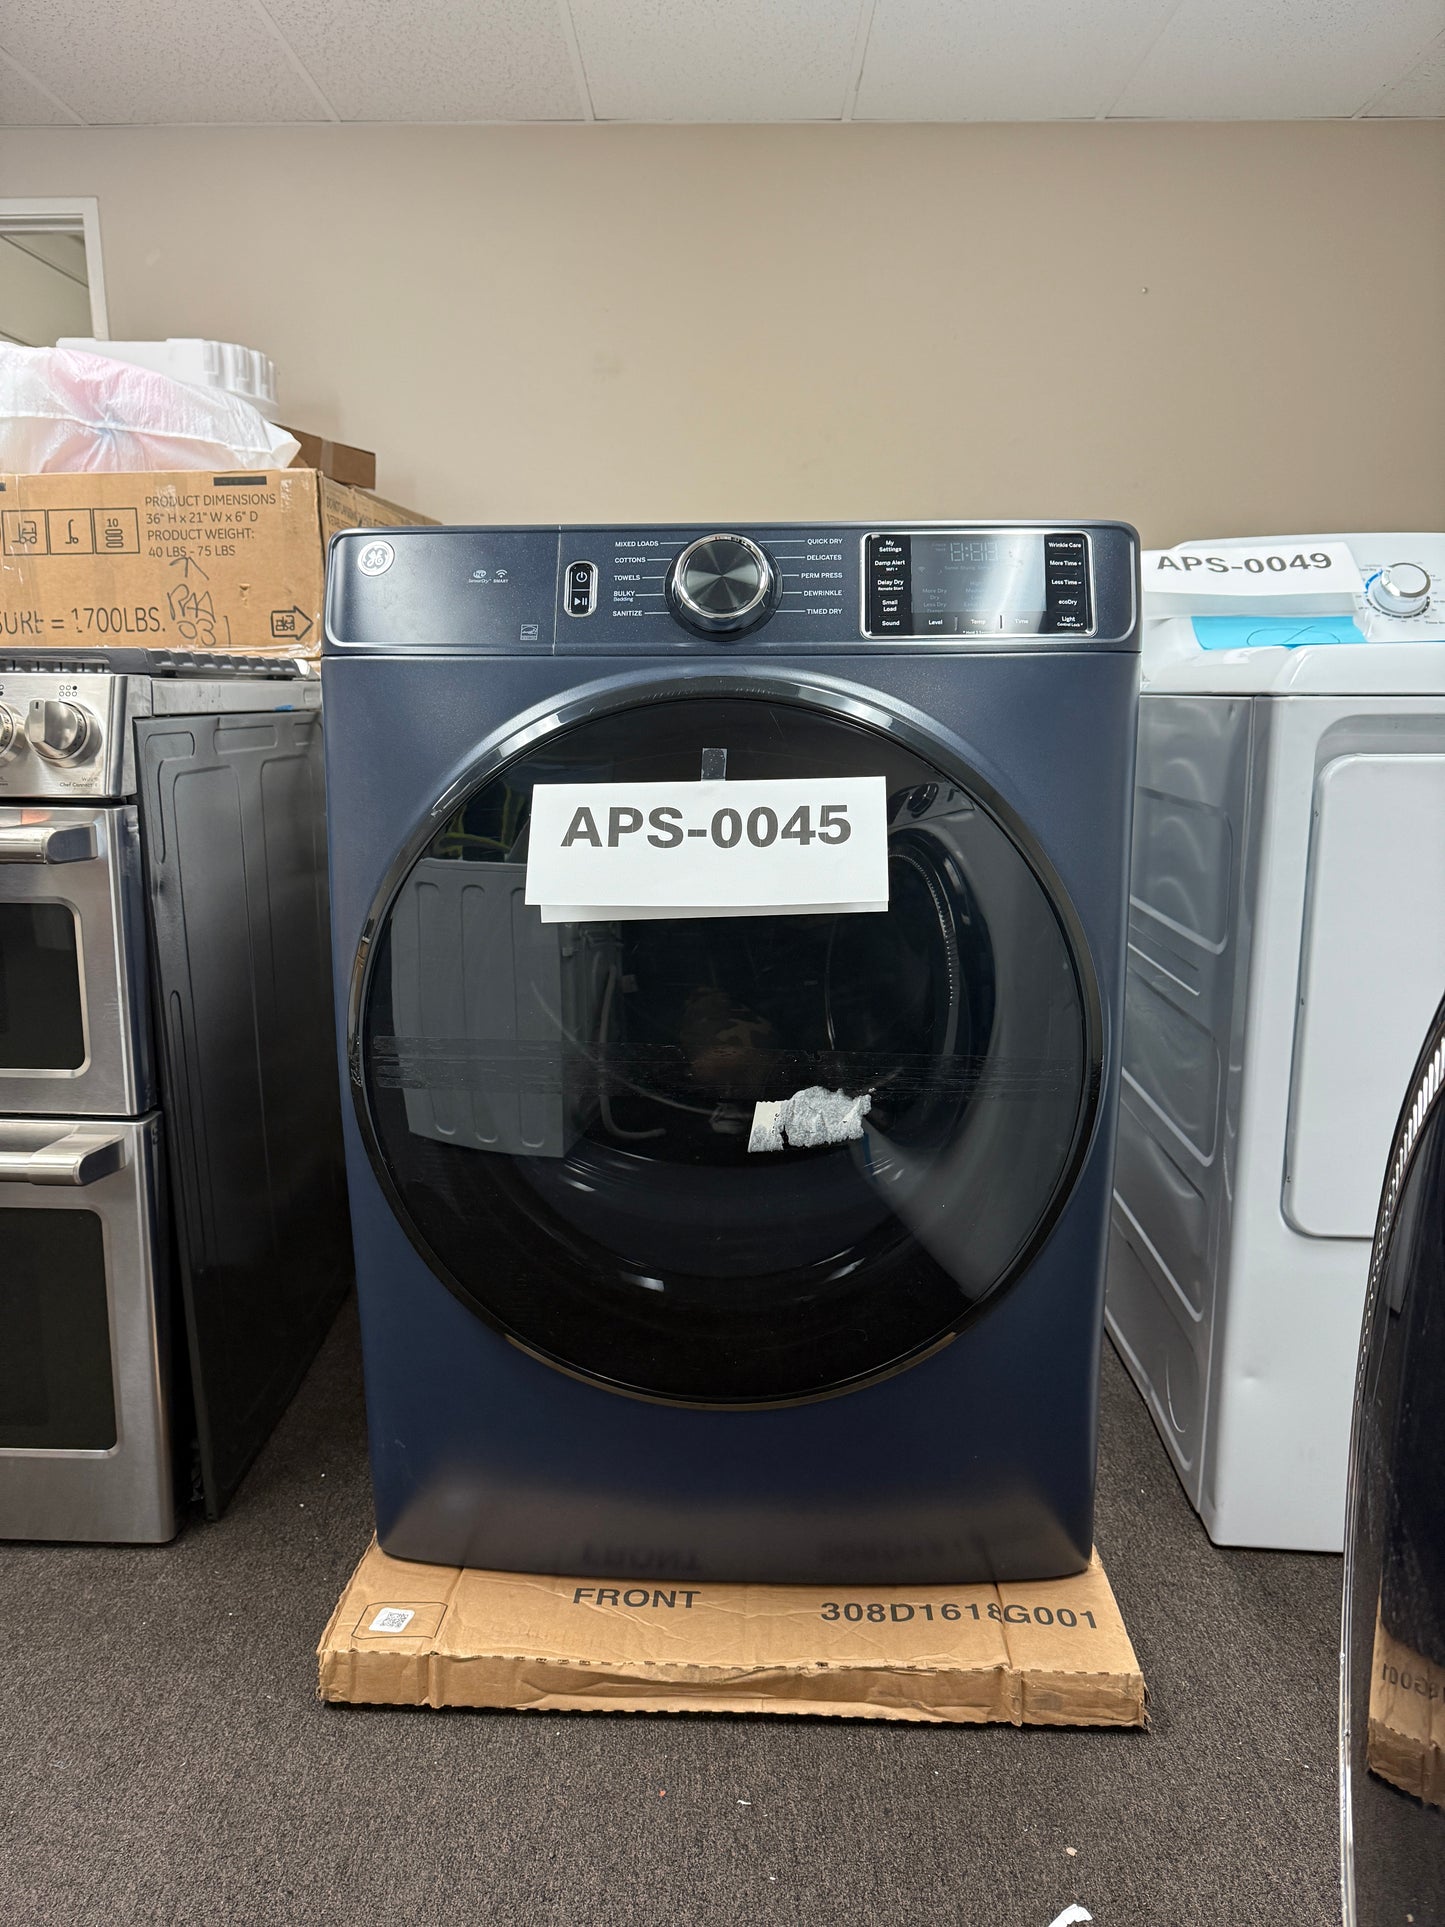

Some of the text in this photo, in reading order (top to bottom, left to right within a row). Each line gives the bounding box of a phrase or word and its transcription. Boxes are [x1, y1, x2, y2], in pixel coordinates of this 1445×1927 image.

[145, 493, 276, 507] PRODUCT DIMENSIONS
[107, 518, 119, 528] 10
[146, 511, 258, 524] 36" H x 21" W x 6" D
[147, 527, 255, 541] PRODUCT WEIGHT:
[148, 547, 163, 558] 40
[166, 546, 187, 557] LBS
[198, 545, 212, 557] 75
[215, 545, 236, 556] LBS
[1157, 552, 1332, 574] APS-0049
[0, 610, 44, 635] URE
[560, 804, 852, 849] APS-0045
[573, 1588, 701, 1608] FRONT
